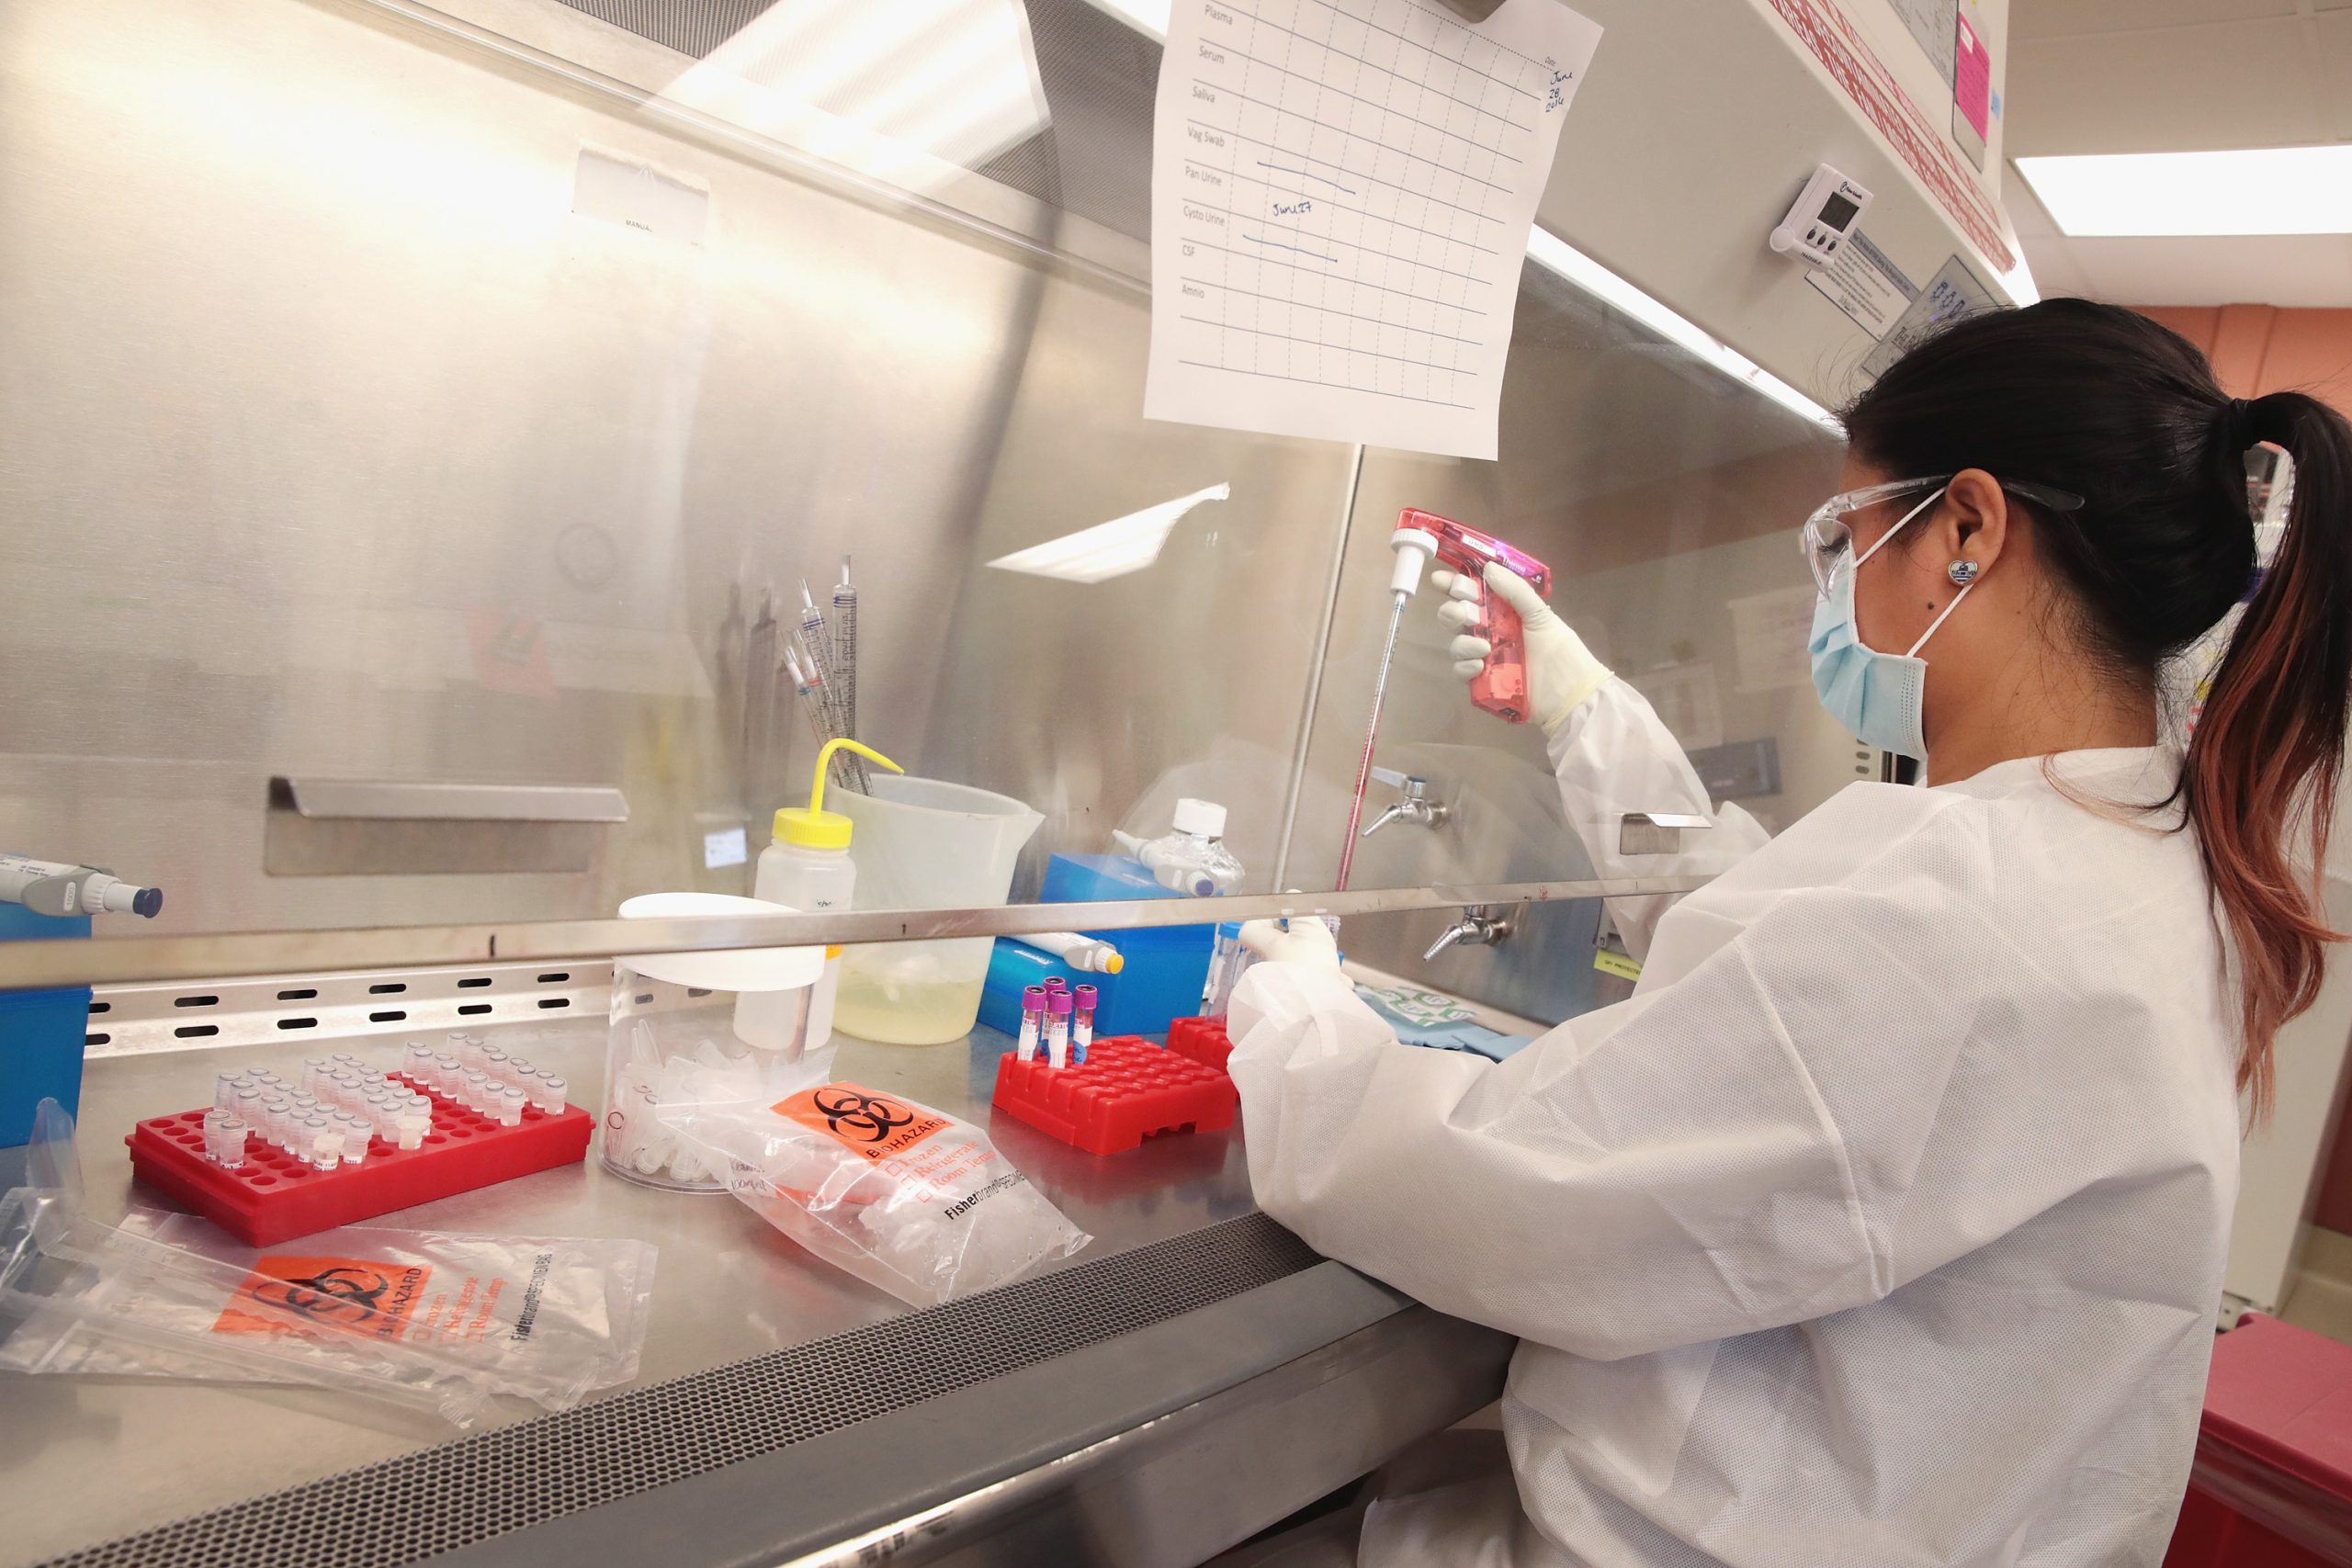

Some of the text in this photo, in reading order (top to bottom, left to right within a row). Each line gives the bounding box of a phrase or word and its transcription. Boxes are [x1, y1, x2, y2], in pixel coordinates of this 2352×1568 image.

[1204, 4, 1233, 26] Plasma
[1199, 45, 1225, 64] Serum
[1193, 85, 1216, 103] Saliva
[1549, 87, 1560, 99] 28
[1188, 126, 1225, 147] Vag Swab
[1185, 165, 1223, 186] Pan Urine
[1183, 205, 1226, 226] Cysto Urine
[1182, 244, 1195, 257] CSF
[865, 1117, 947, 1158] BIOHAZARD
[929, 1167, 967, 1190] Room
[377, 1268, 423, 1337] BIOHAZARD
